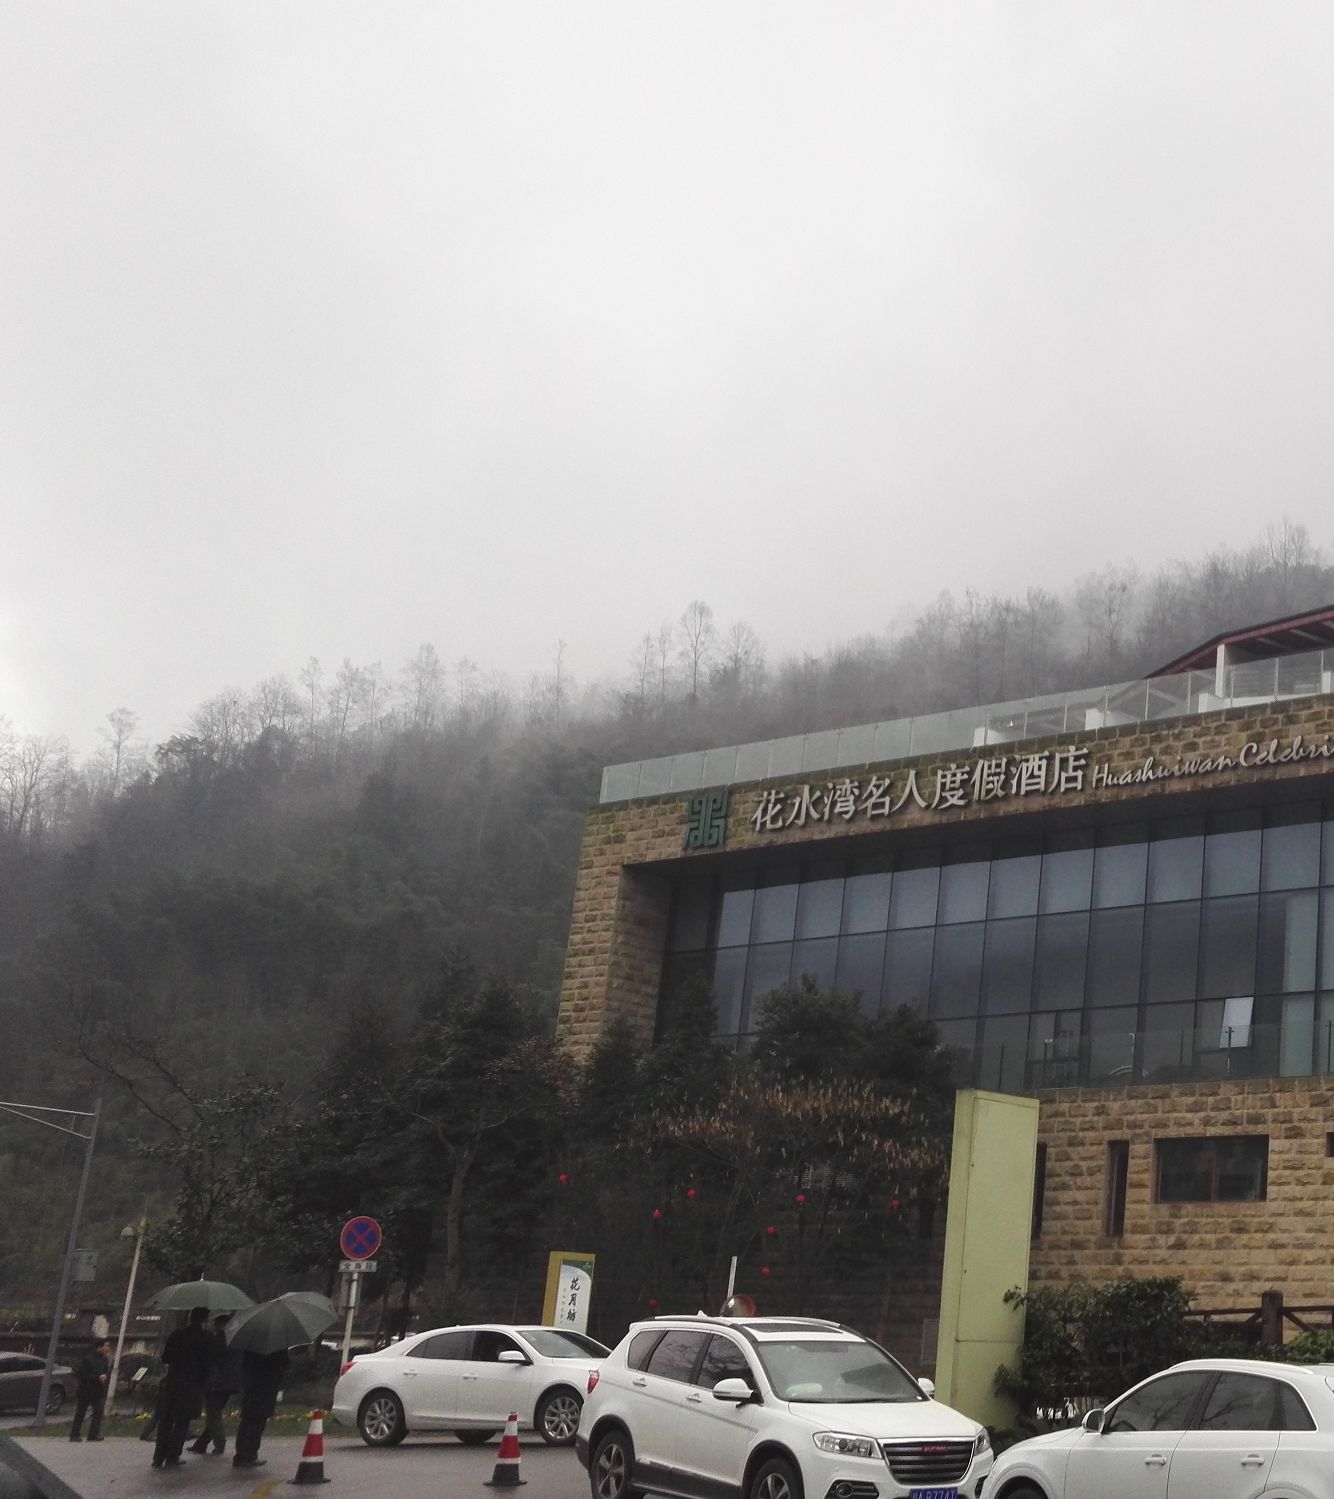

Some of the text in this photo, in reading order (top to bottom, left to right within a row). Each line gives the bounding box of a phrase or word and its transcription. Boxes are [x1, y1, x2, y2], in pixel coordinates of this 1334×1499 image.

[751, 745, 1090, 833] 花水湾名人度假酒店
[1092, 756, 1236, 789] Huashuiwan
